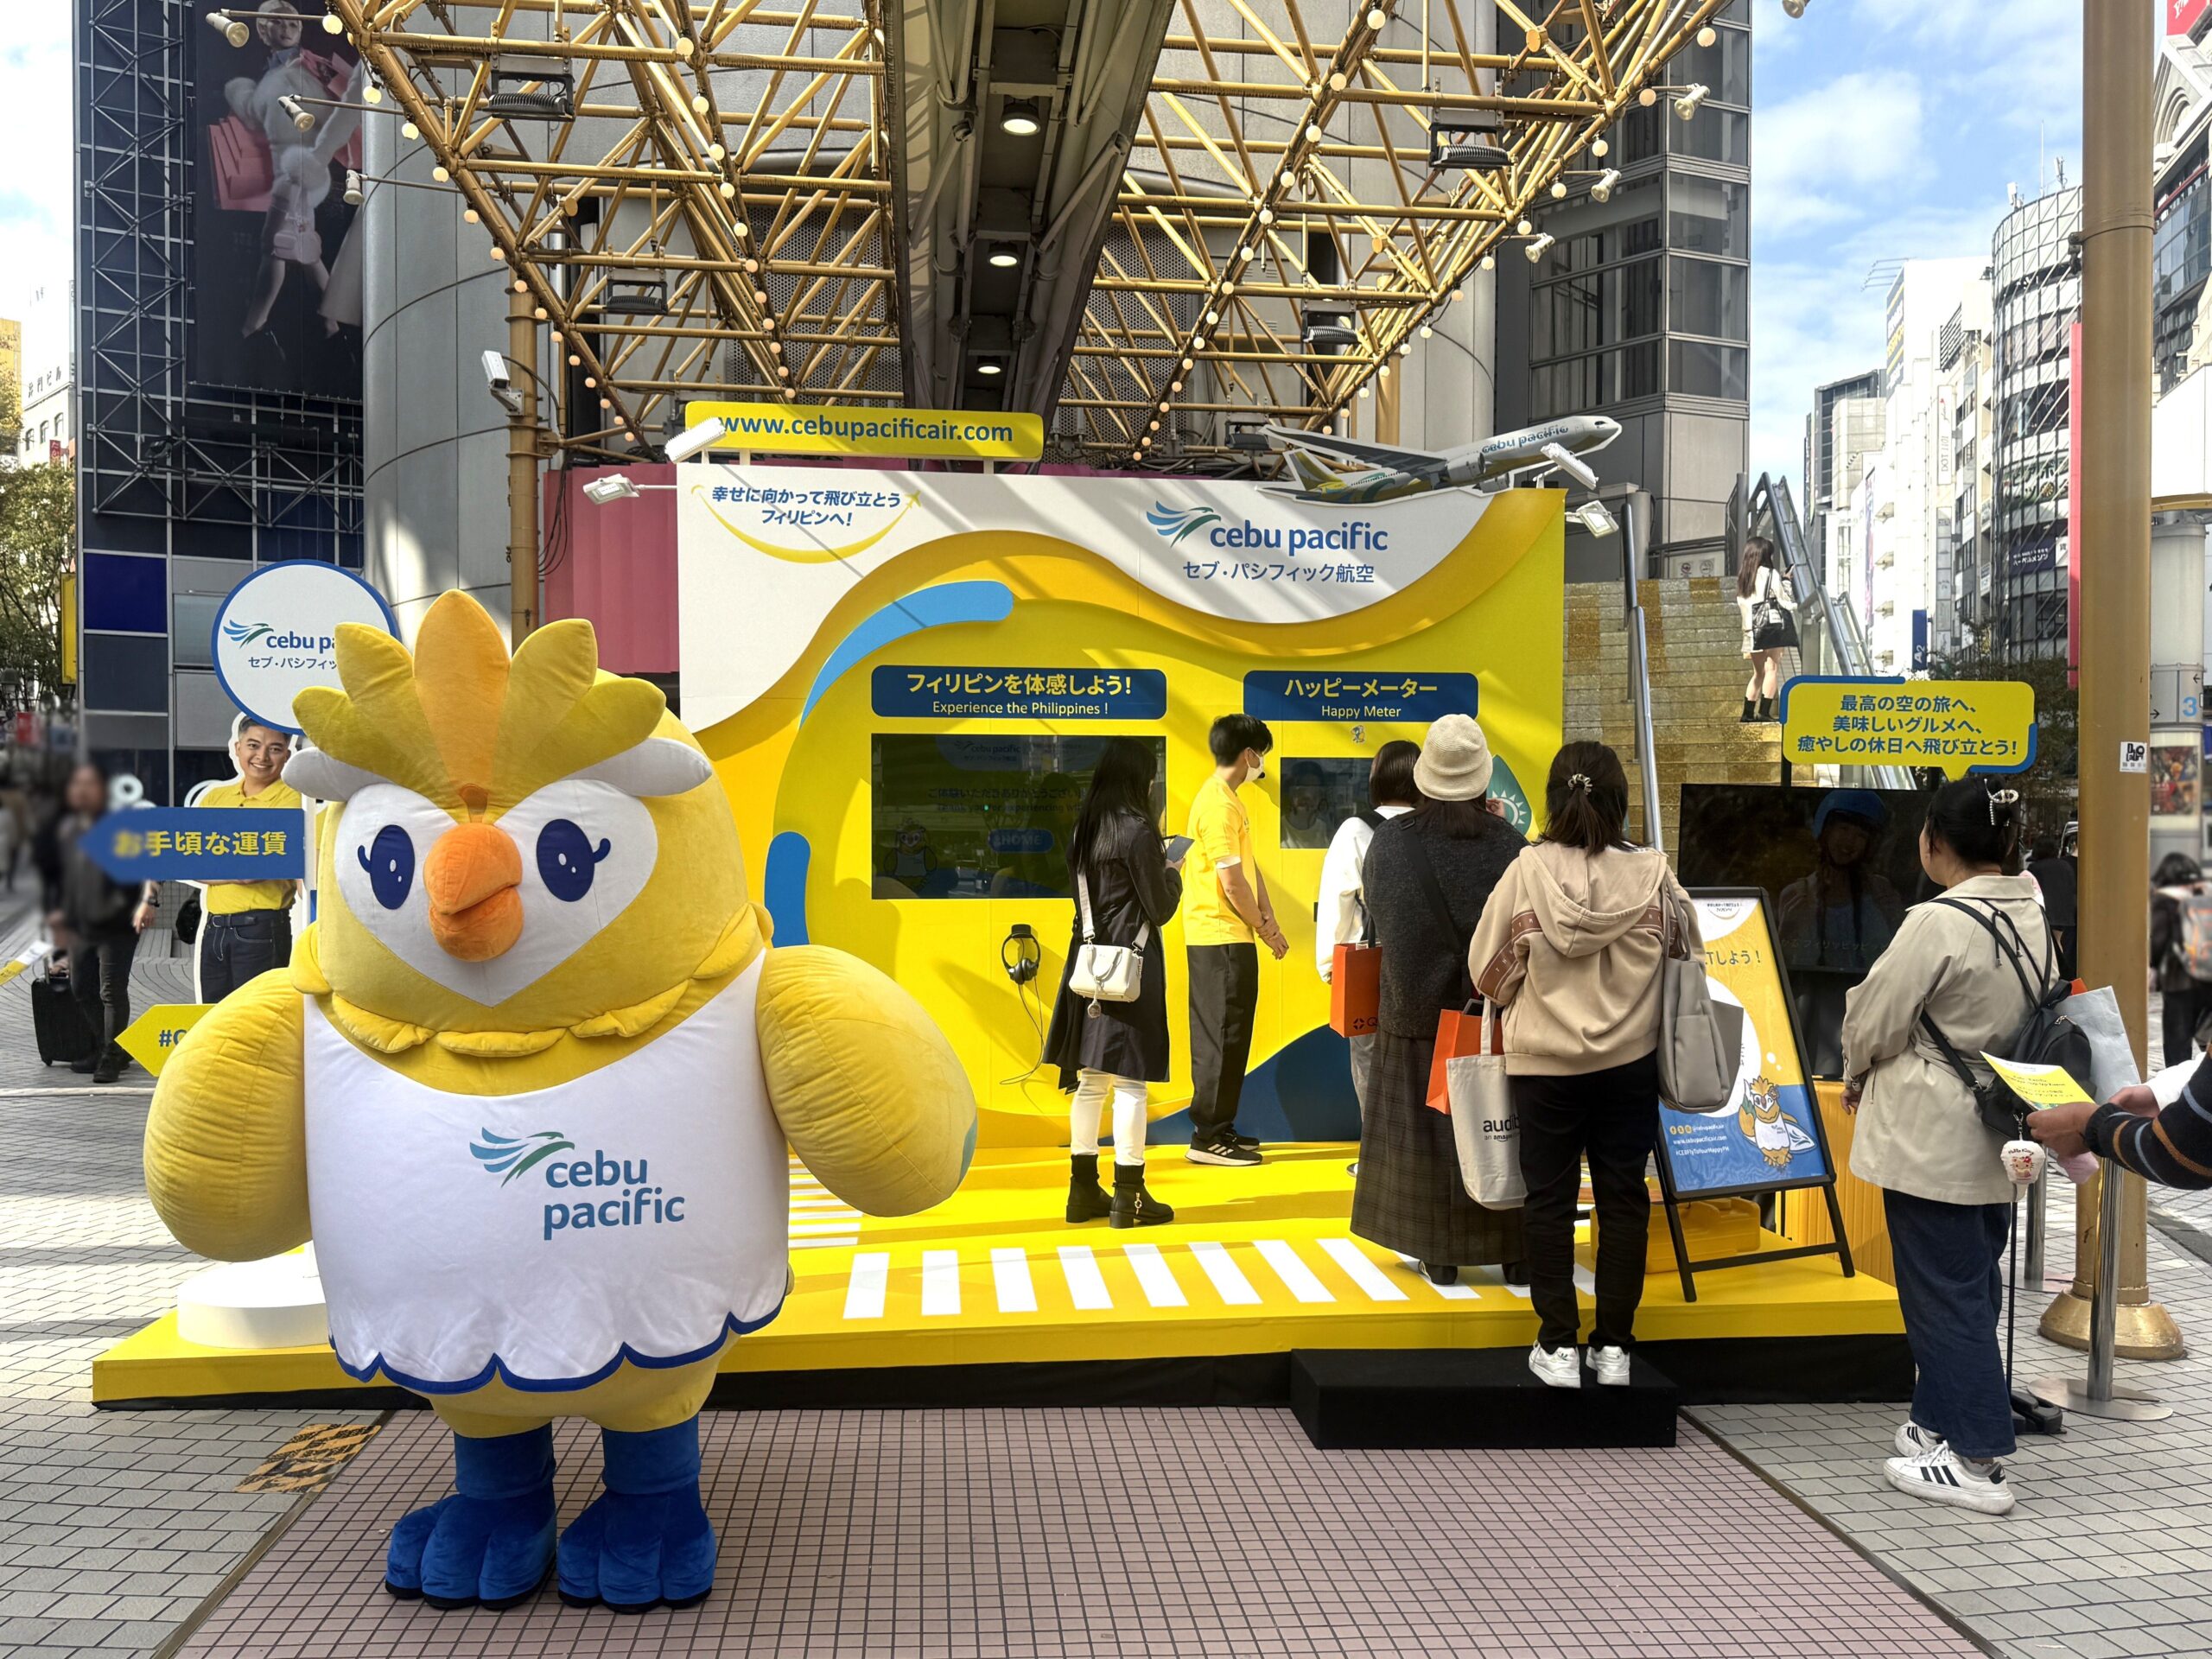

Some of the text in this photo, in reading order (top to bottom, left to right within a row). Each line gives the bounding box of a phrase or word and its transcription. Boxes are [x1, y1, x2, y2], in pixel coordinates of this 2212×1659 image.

[718, 414, 1014, 442] www.cebupacificair.com
[1481, 424, 1569, 454] cebu pacific
[712, 486, 901, 508] 幸せに向かって飛び立とう
[1210, 519, 1389, 556] cebu pacific
[1182, 561, 1376, 584] セブ・パシフィック航空
[265, 630, 315, 649] cebu
[1914, 645, 1925, 664] A2
[906, 672, 1132, 696] フィリピンを体感しよう!
[1284, 677, 1438, 699] ハッピーメーター
[932, 701, 1003, 715] Experience
[1006, 702, 1028, 714] the
[1032, 702, 1101, 716] Philippines
[1321, 705, 1402, 719] Happy Meter
[1840, 695, 1976, 713] 最高の空の旅へ、
[2182, 696, 2198, 717] 3
[1833, 715, 1982, 734] 美味しいグルメへ、
[113, 830, 288, 858] お手頃な運賃
[545, 1149, 648, 1189] cebu
[543, 1186, 685, 1241] pacific
